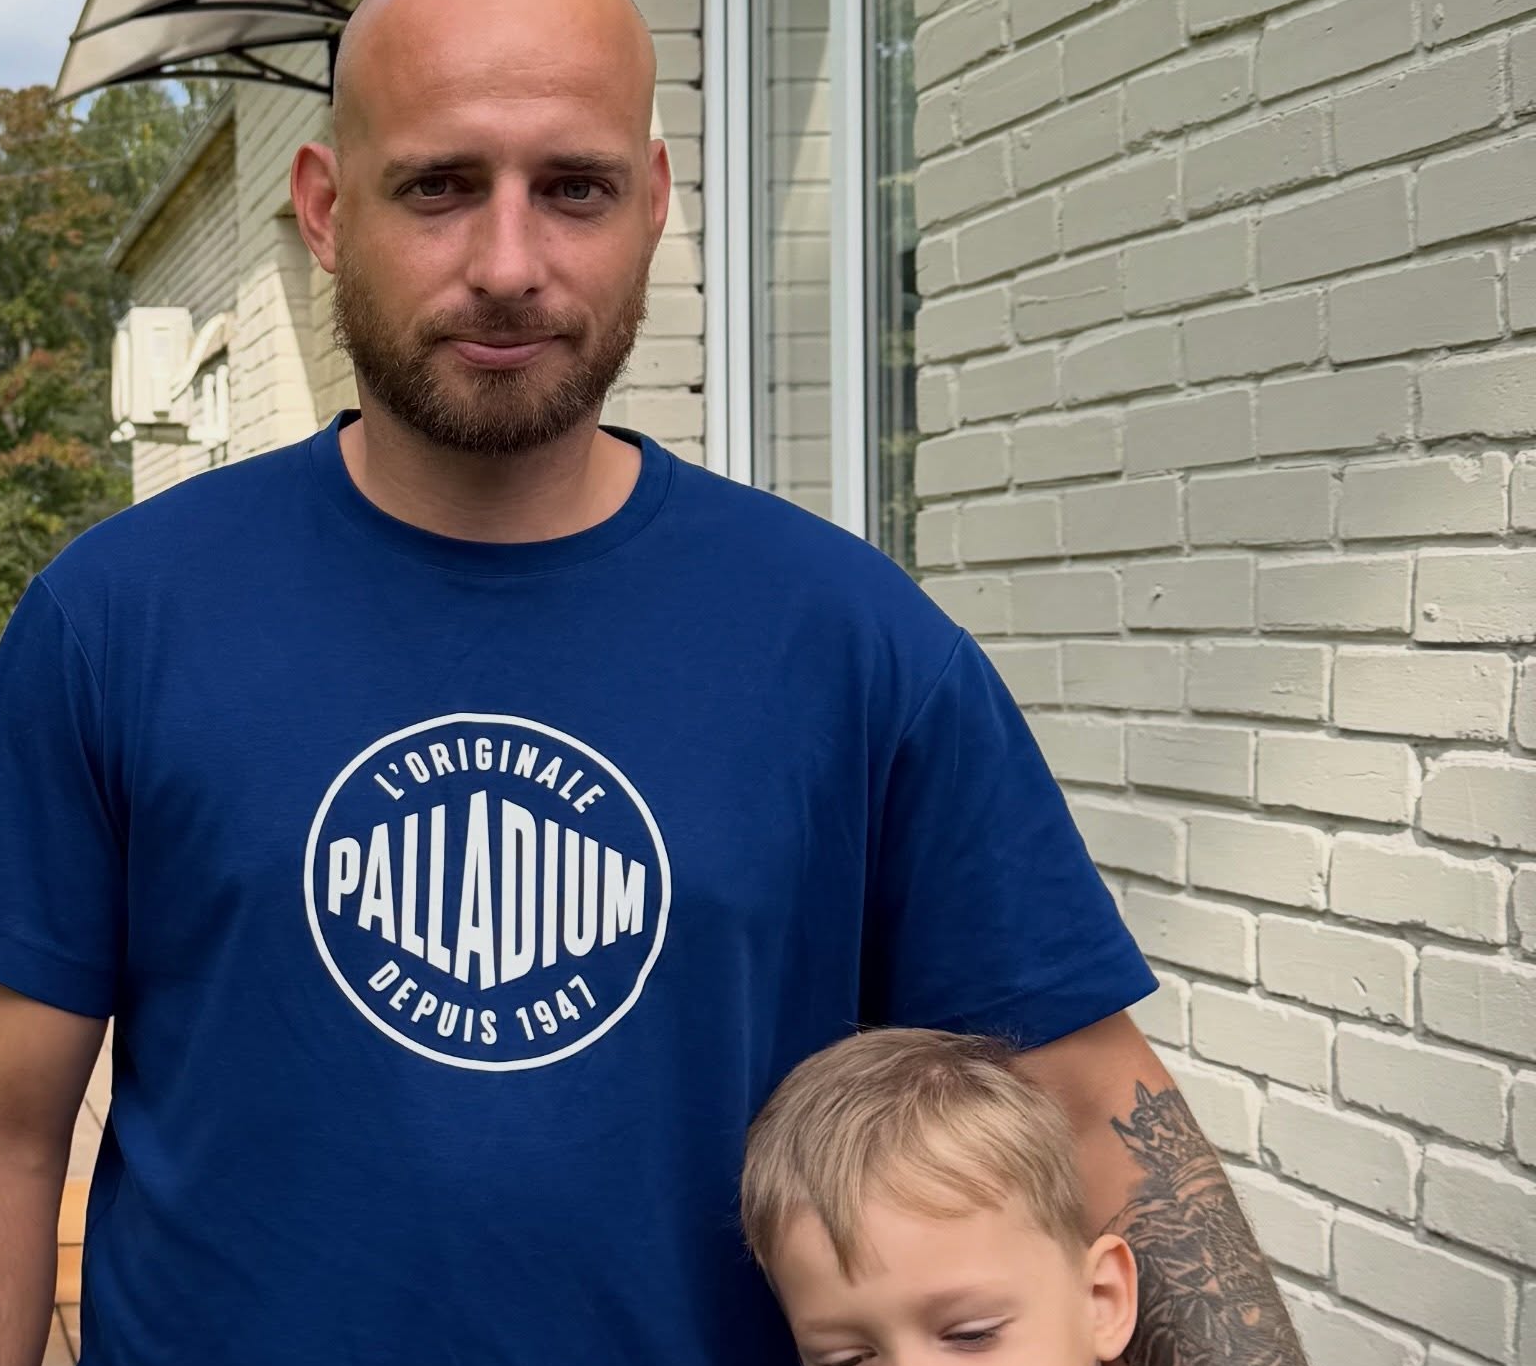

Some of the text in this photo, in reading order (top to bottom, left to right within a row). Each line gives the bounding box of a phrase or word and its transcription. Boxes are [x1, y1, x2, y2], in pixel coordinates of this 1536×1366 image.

[373, 737, 606, 814] L'ORIGINALE
[327, 789, 646, 991] PALLADIUM
[367, 959, 596, 1045] DEPUIS 1947
